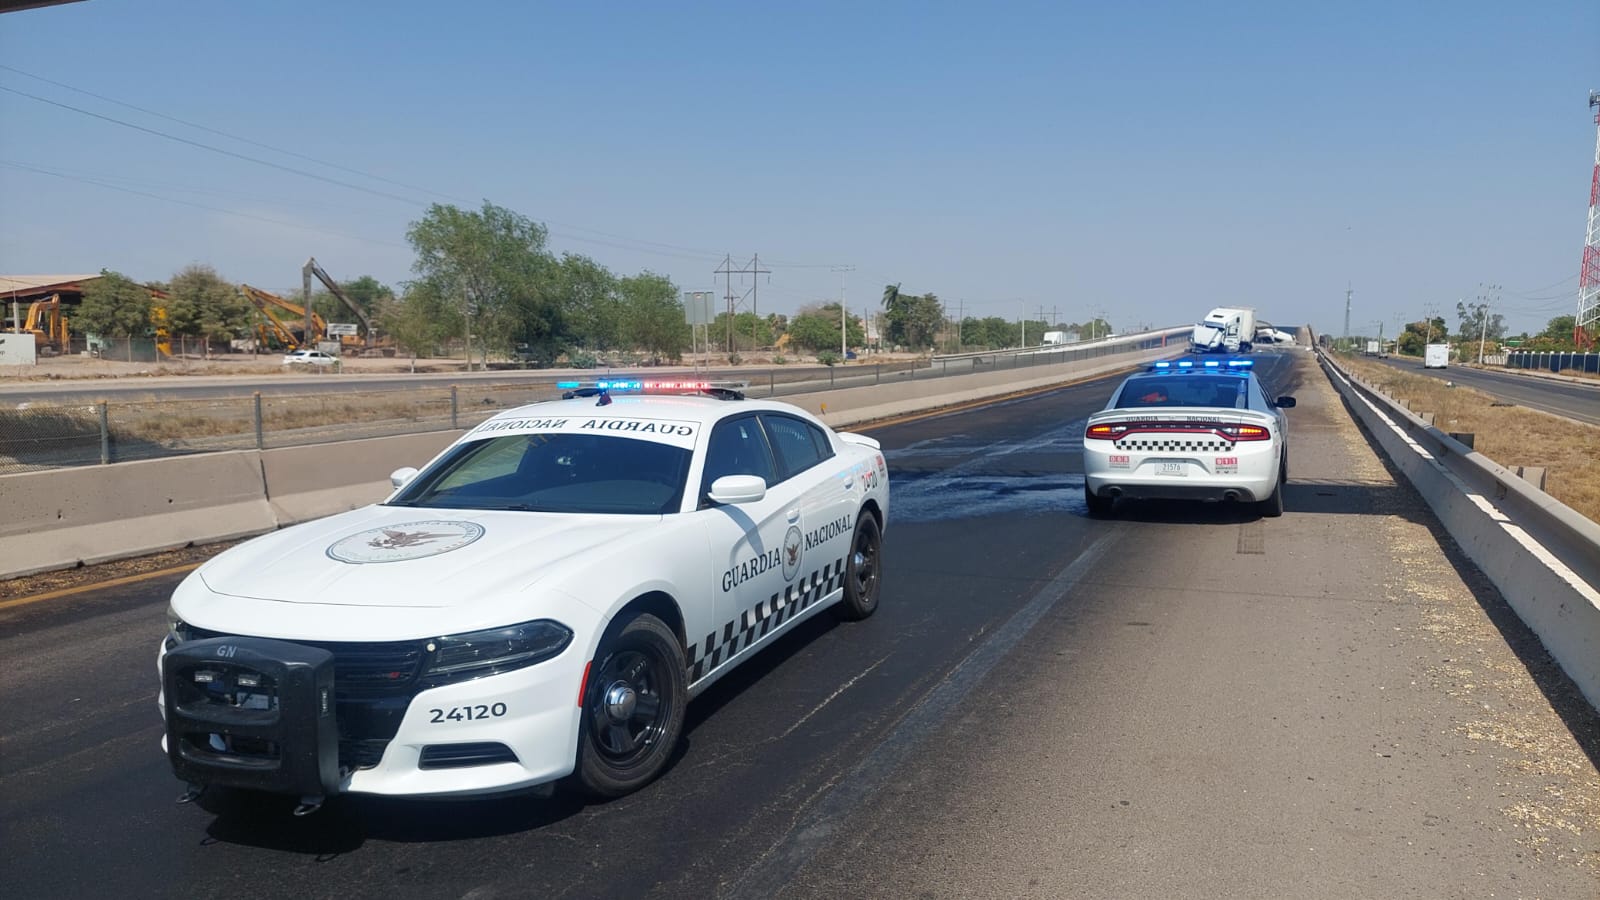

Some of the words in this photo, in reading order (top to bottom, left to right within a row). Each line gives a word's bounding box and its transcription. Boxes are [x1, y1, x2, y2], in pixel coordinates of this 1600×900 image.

[722, 547, 782, 593] GUARDIA
[804, 514, 853, 551] NACIONAL
[216, 645, 238, 658] GN
[429, 702, 507, 723] 24120
